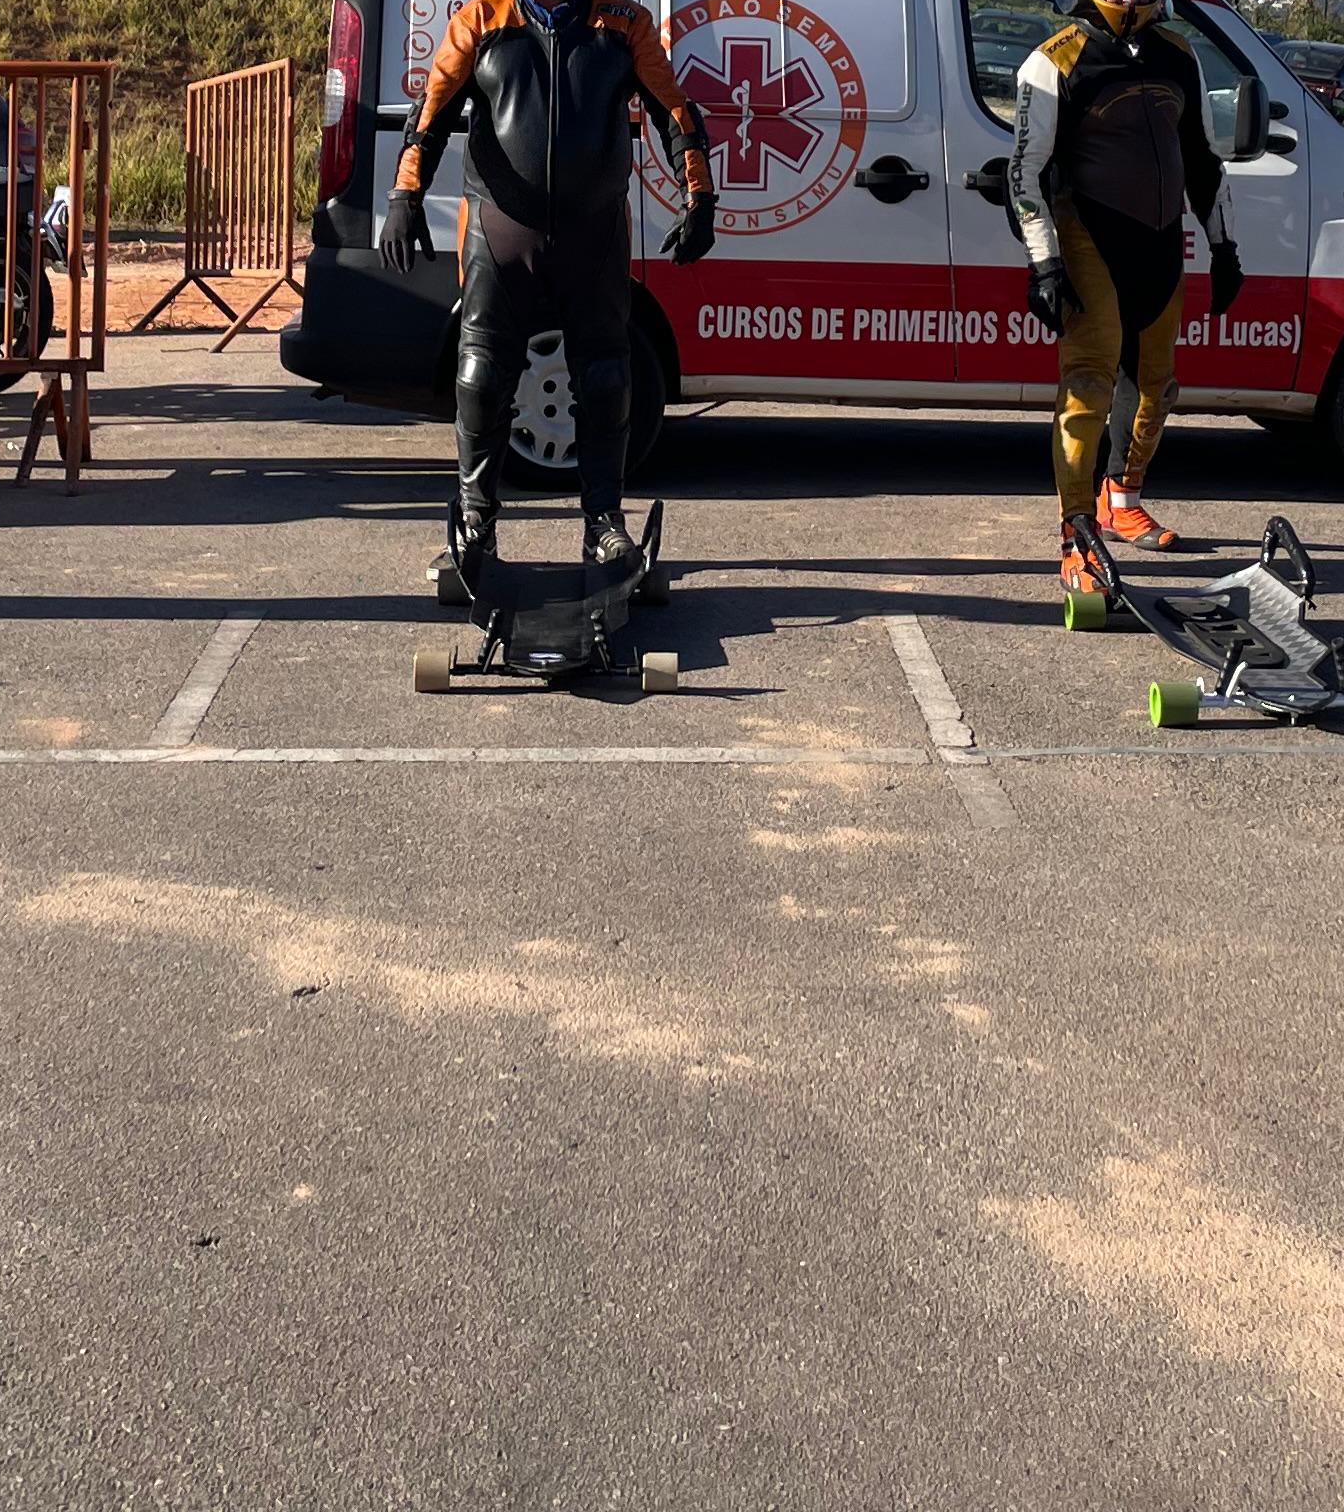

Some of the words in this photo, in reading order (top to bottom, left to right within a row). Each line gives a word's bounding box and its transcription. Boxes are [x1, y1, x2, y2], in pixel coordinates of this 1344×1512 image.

[776, 5, 861, 121] SEMPRE
[641, 156, 680, 203] VAI
[773, 165, 843, 223] SAMU
[697, 304, 803, 340] CURSOS
[811, 307, 845, 341] DE
[852, 308, 999, 345] PRIMEIROS
[1006, 311, 1057, 345] SOC
[1218, 314, 1303, 354] Lucas)
